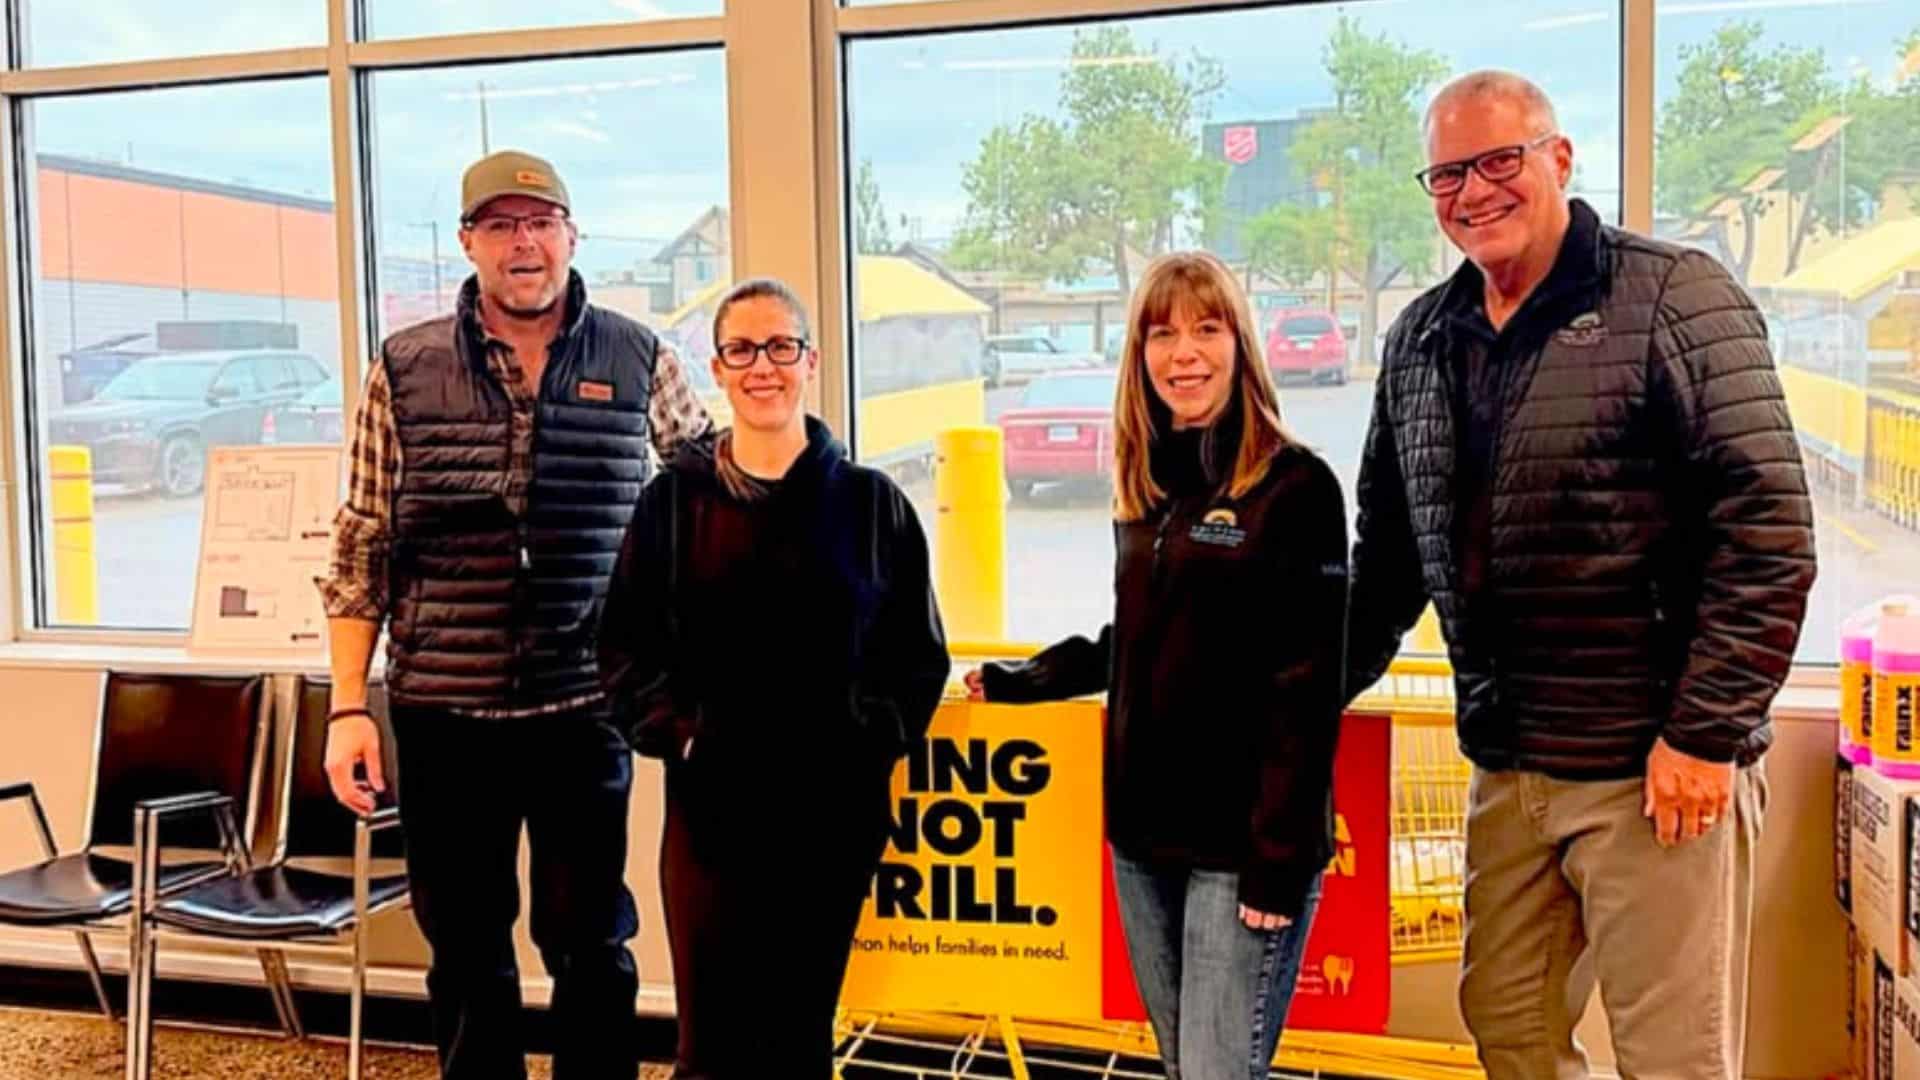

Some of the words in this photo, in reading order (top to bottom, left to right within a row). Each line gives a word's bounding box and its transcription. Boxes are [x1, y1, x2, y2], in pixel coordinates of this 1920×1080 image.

[907, 737, 1052, 797] ING
[888, 797, 1027, 858] NOT
[876, 862, 1059, 927] RILL.
[888, 933, 930, 956] helps
[935, 935, 998, 957] families
[1003, 940, 1019, 958] in
[1023, 941, 1070, 961] need.
